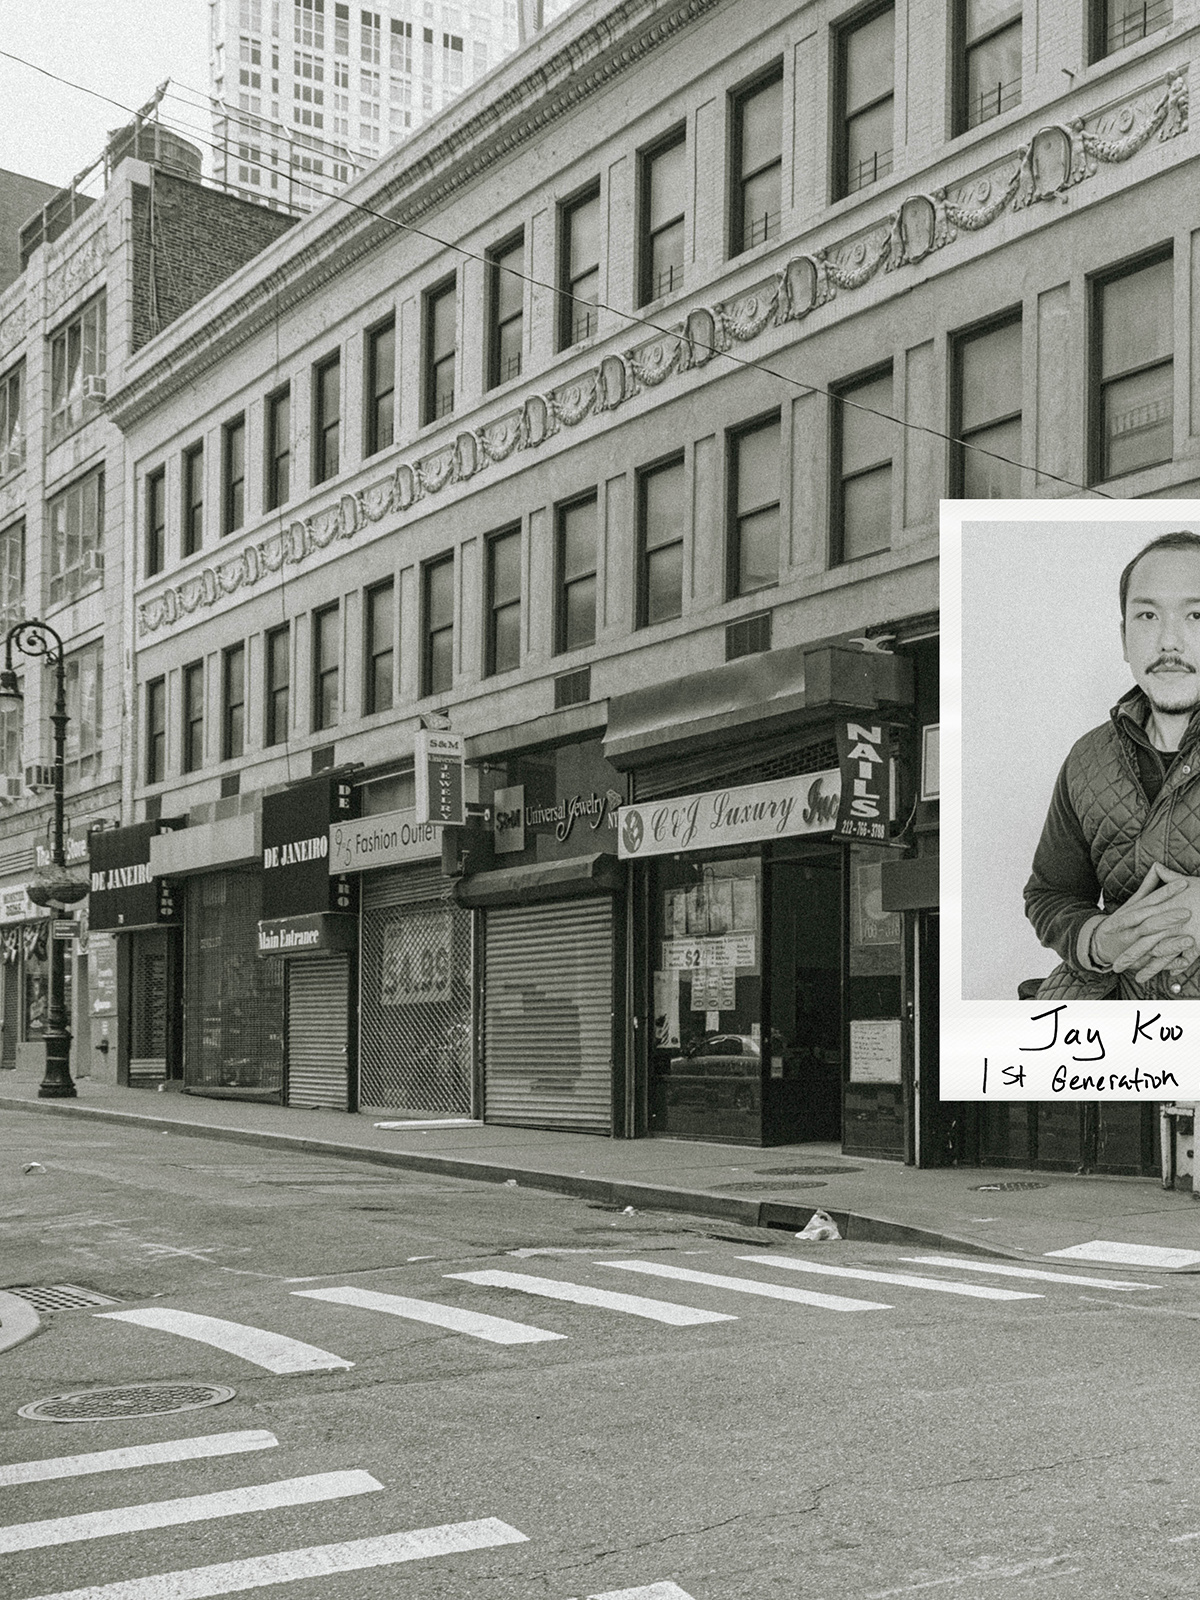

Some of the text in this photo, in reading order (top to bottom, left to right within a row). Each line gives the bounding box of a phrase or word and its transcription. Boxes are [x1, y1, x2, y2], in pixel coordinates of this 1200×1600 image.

[429, 738, 459, 750] S&M
[846, 722, 884, 818] NAILS
[439, 764, 452, 820] JEWELRY
[526, 792, 606, 842] Universal Jewelry
[710, 792, 794, 833] Luxury
[263, 835, 328, 869] DE JANEIRO
[356, 828, 397, 854] Fashion
[401, 823, 437, 846] Outlet
[91, 862, 153, 892] DE JANEIRO
[258, 928, 320, 950] Main Entrance
